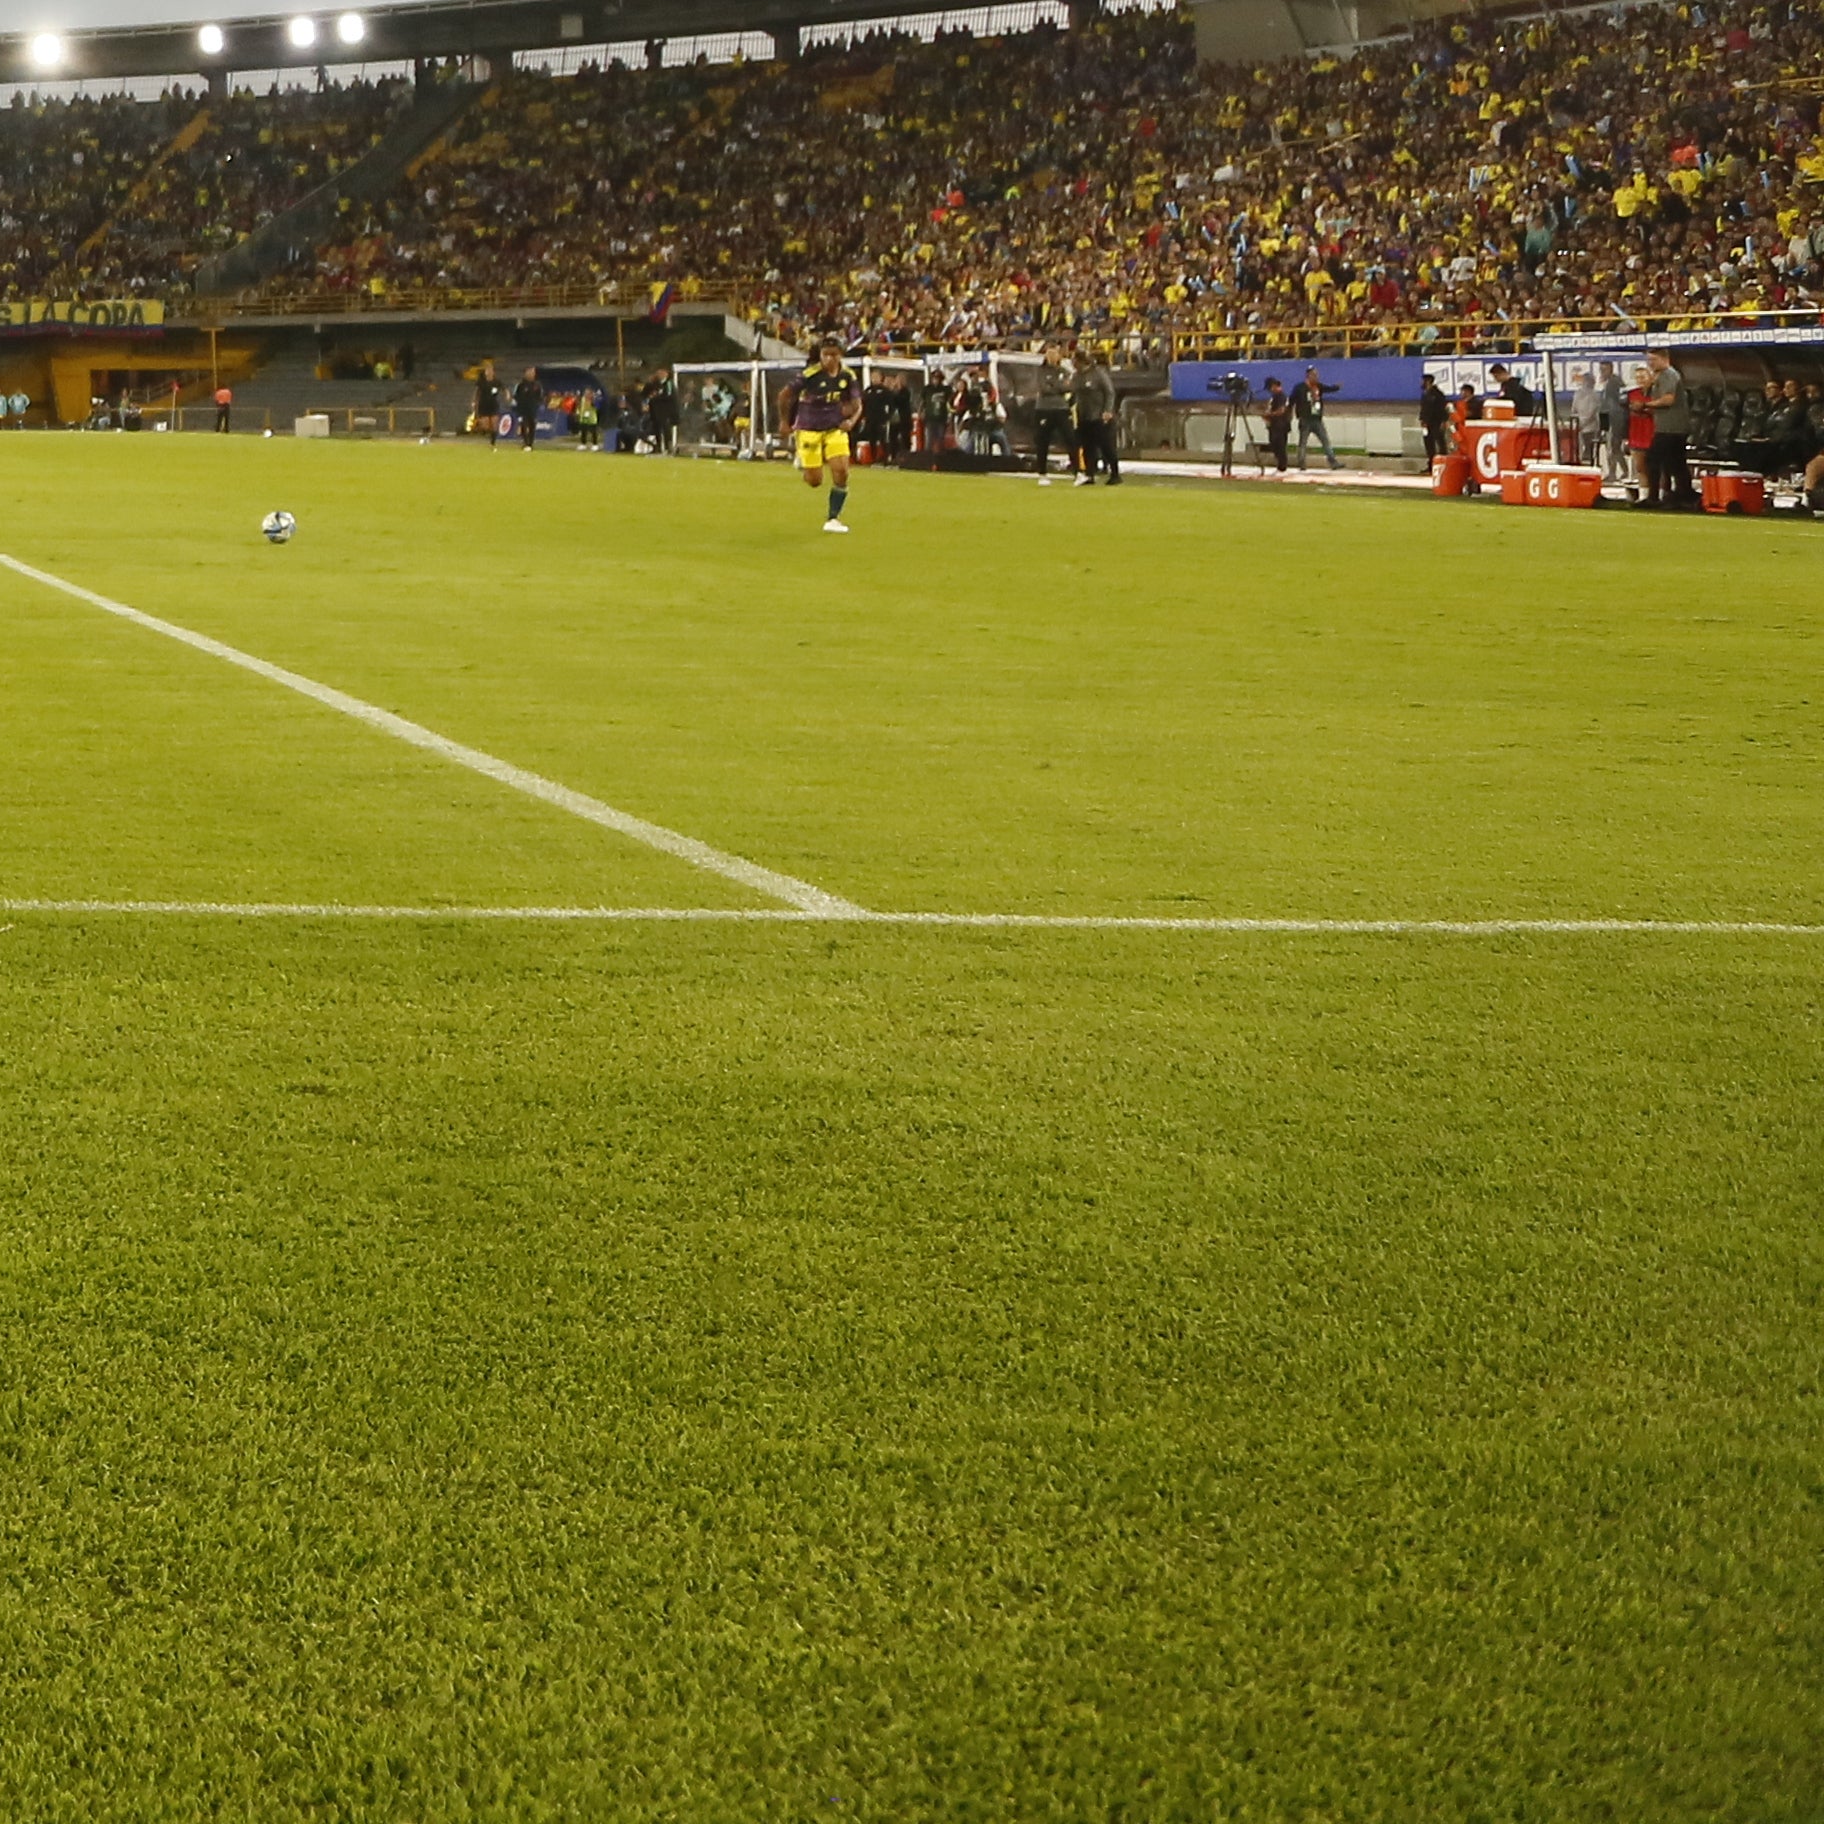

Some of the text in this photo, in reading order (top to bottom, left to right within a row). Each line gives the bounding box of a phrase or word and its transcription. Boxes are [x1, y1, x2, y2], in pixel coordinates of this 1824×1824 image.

[67, 301, 145, 326] COPA
[1476, 432, 1499, 479] G
[1529, 478, 1558, 498] G G
